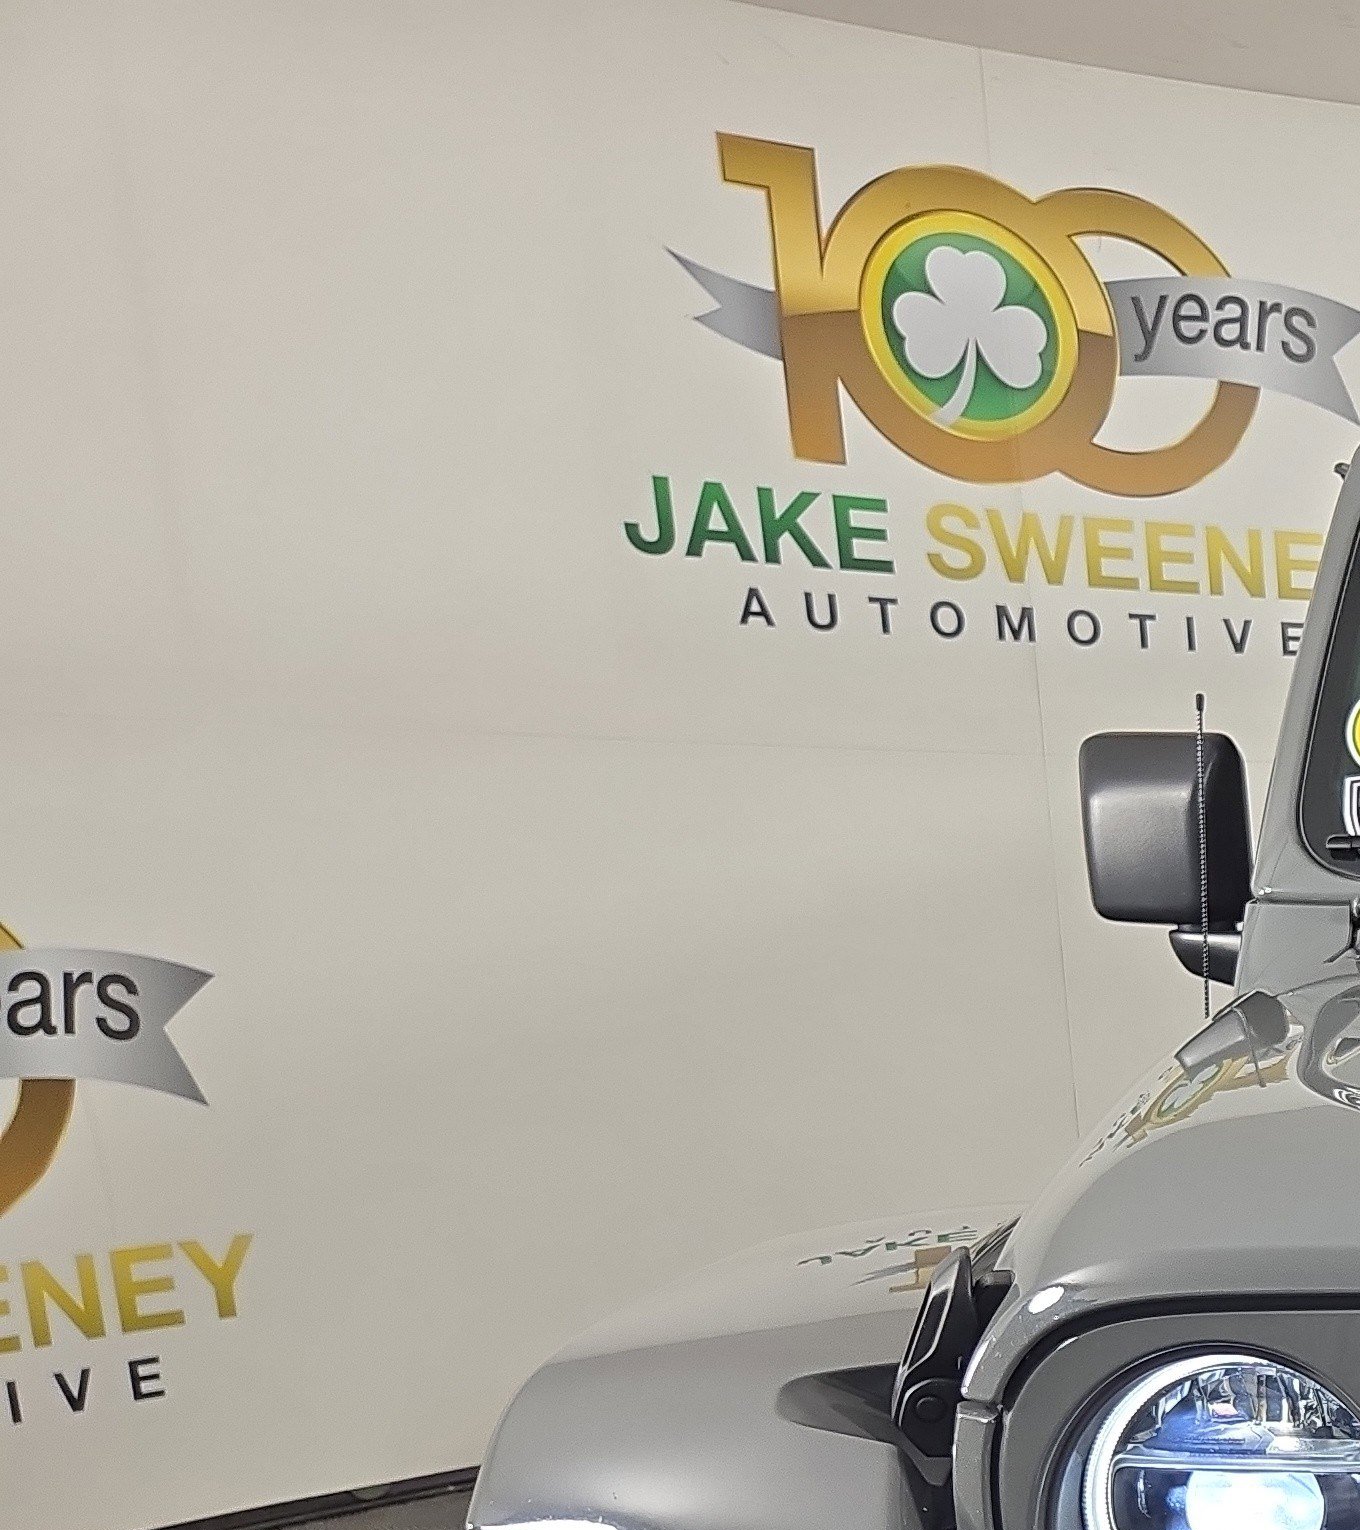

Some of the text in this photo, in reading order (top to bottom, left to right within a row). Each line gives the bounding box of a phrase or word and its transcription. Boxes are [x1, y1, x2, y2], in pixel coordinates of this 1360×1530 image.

[716, 132, 1260, 497] 100
[1130, 293, 1318, 363] years
[624, 475, 1323, 600] JAKE SWEENE
[739, 587, 1304, 656] AUTOMOTIVE
[5, 970, 140, 1041] ars
[5, 1356, 166, 1424] IVE
